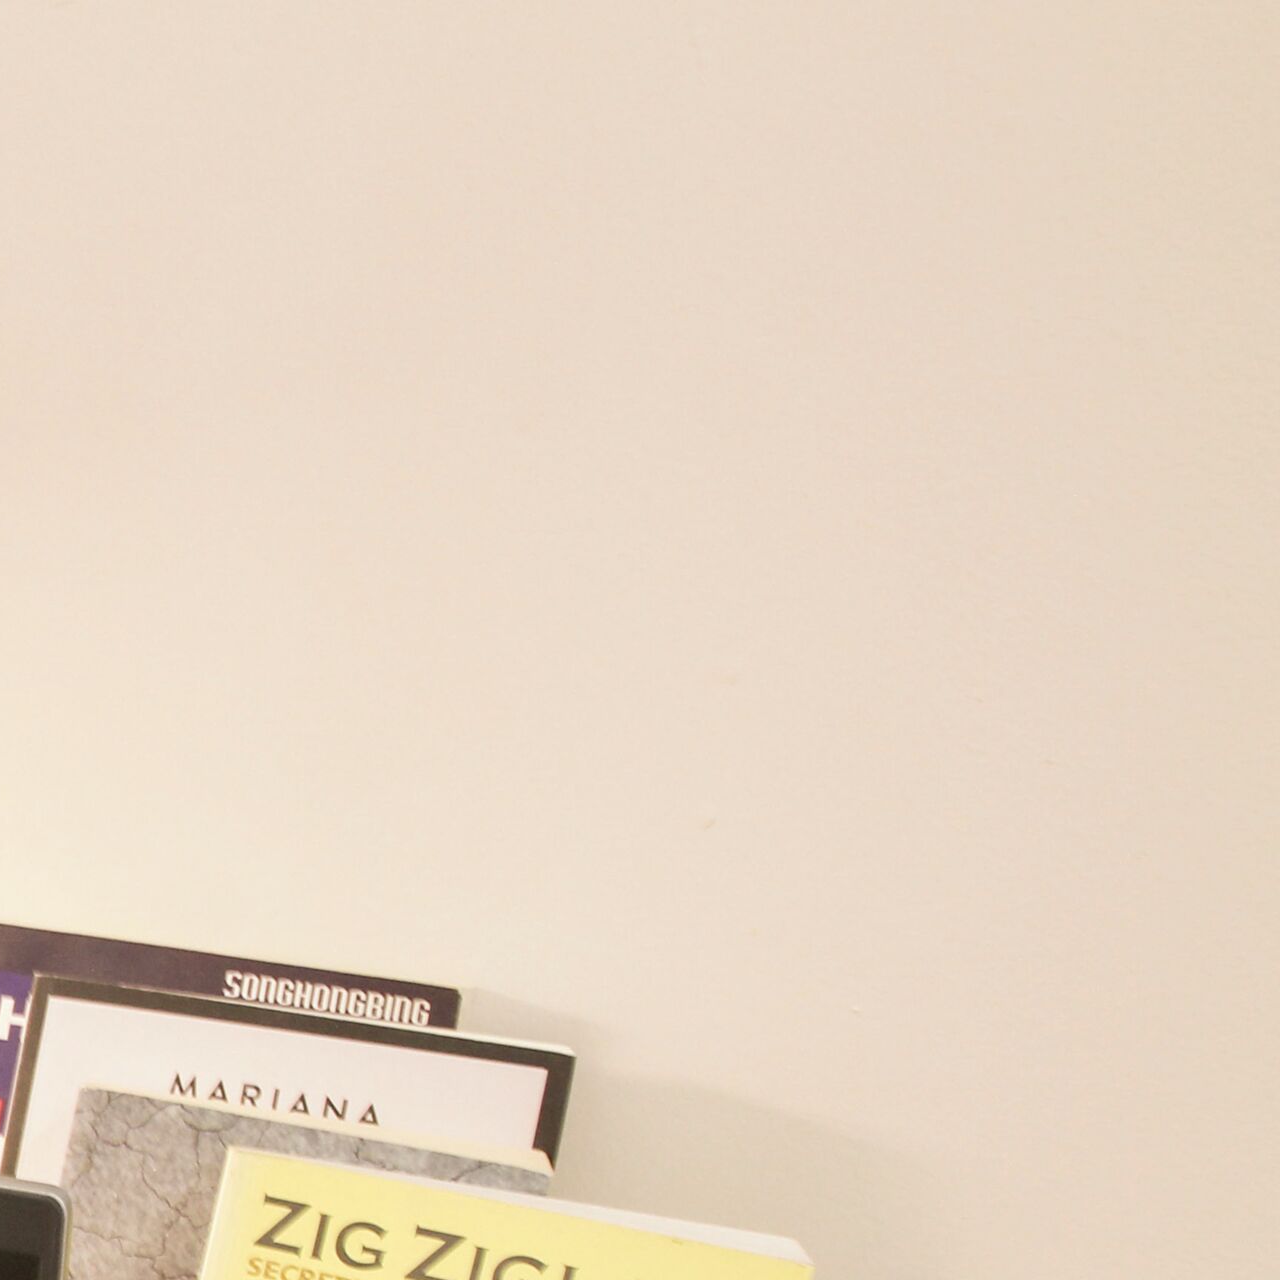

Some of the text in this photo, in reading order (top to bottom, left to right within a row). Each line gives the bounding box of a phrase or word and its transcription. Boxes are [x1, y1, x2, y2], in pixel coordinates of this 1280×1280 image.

[222, 968, 432, 1027] SONGHONGBING
[170, 1072, 380, 1126] MARIANA
[253, 1192, 388, 1271] ZIG
